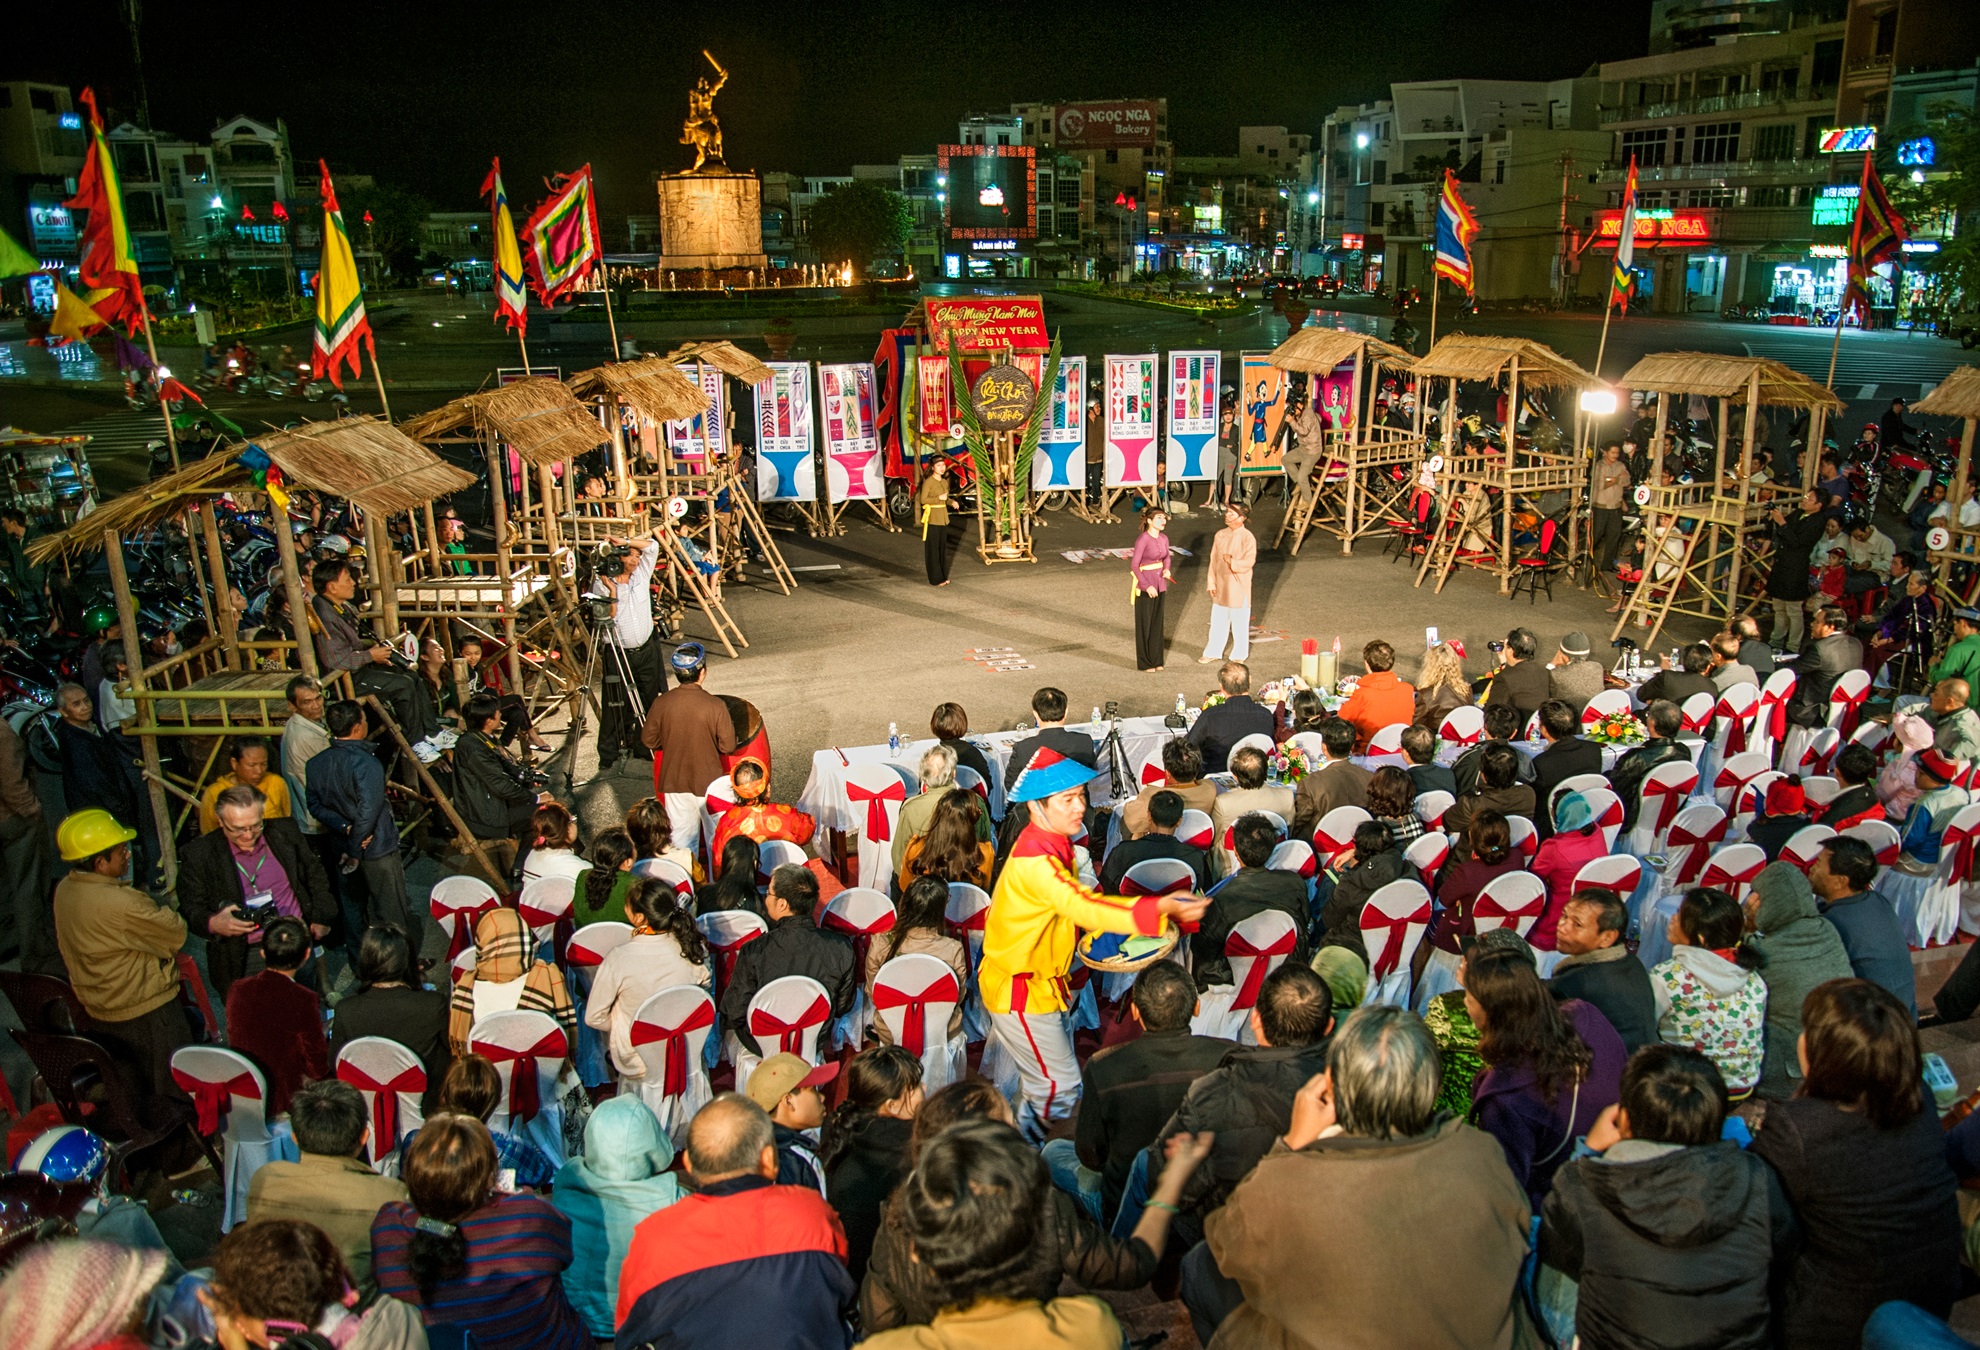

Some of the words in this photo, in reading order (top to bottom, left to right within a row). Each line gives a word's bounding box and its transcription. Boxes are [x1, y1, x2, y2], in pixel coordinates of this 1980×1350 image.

[1088, 110, 1122, 124] NGỌC
[1125, 109, 1151, 121] NGA
[1115, 124, 1151, 135] Bakery
[36, 213, 71, 226] Canon
[1661, 219, 1706, 235] NGA
[981, 327, 1006, 335] NEW
[1009, 326, 1039, 335] YEAR
[955, 427, 961, 436] 9
[1433, 459, 1440, 469] 7
[1637, 490, 1645, 500] 6
[674, 502, 682, 513] 2
[1931, 532, 1943, 547] 5
[569, 557, 574, 568] 3
[409, 641, 415, 656] 4
